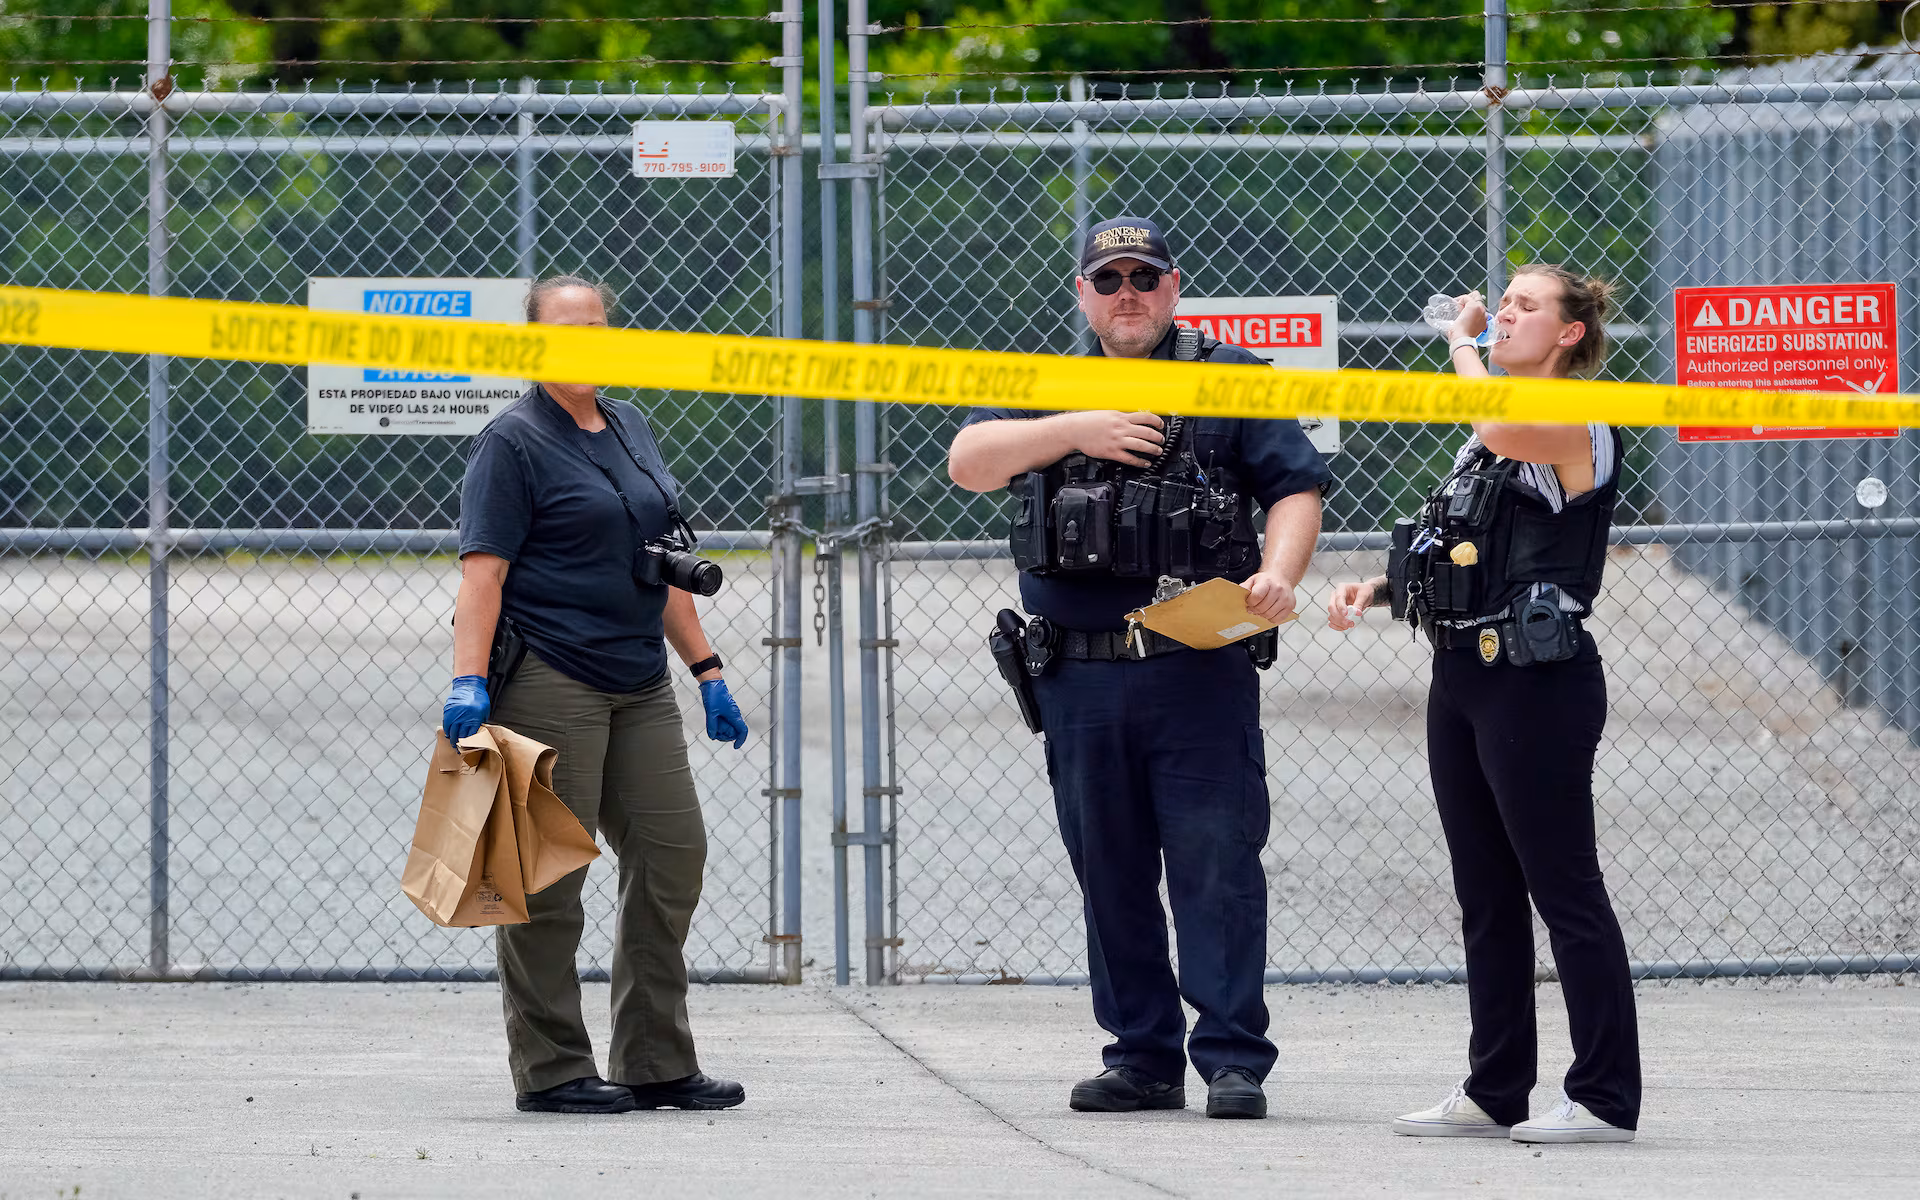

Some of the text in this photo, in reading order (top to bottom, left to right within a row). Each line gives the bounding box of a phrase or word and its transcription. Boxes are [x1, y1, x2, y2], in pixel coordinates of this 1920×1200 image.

[643, 162, 727, 173] 770-795-9100
[1094, 226, 1151, 244] KENNESAW
[1100, 235, 1145, 250] POLICE
[369, 293, 467, 315] NOTICE
[1728, 295, 1880, 326] DANGER
[1686, 332, 1888, 353] ENERGIZED SUBSTATION.
[1686, 355, 1889, 375] Authorized personnel only.
[1687, 378, 1819, 389] Before entering this substation
[319, 389, 521, 399] ESTA PROPIEDAD BAJO VIGILANCIA
[350, 404, 489, 414] DE VIDEO LAS 24 HOURS
